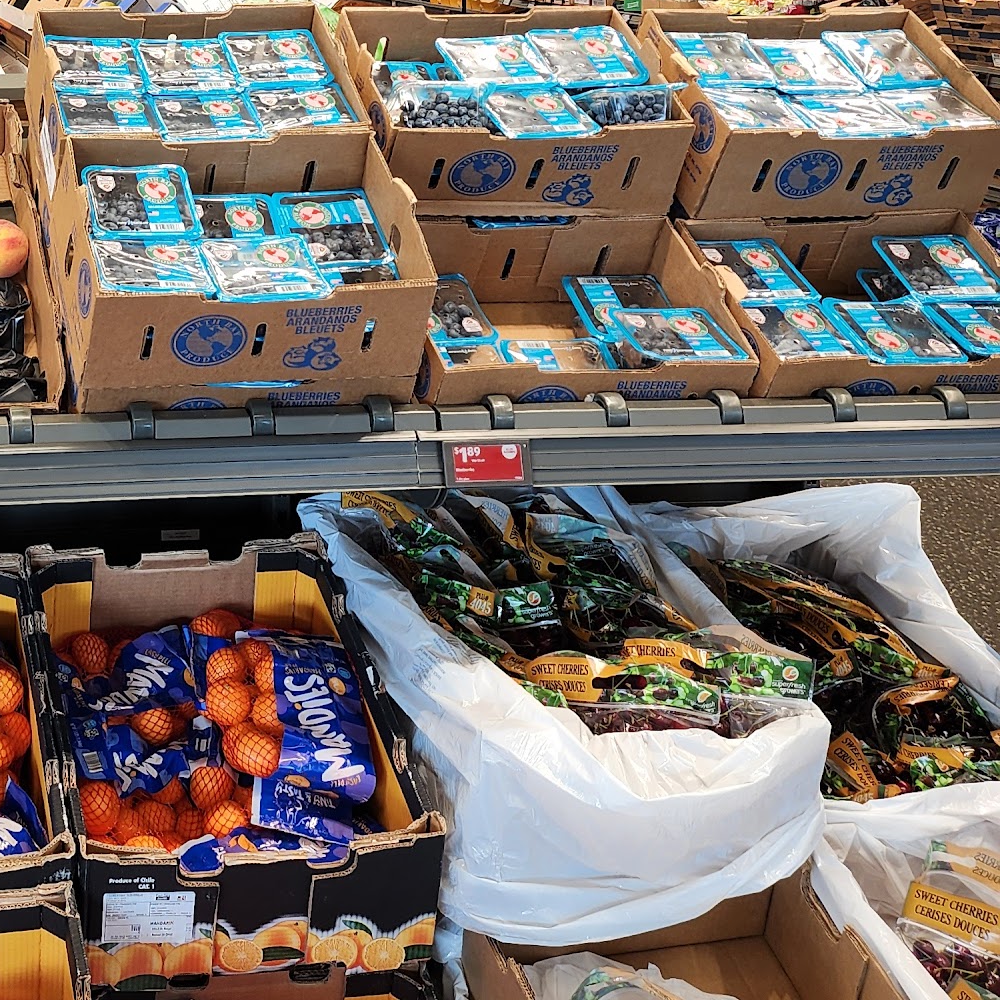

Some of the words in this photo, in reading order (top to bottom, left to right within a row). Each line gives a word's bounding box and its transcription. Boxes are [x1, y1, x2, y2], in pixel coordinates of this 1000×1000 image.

[552, 144, 620, 155] BLUEBERRIES
[879, 144, 945, 154] BLUEBERRIES
[457, 152, 495, 170] NORTH
[496, 154, 511, 171] BAY
[550, 153, 614, 163] ARANDANOS
[785, 152, 823, 171] NORTH
[826, 154, 839, 171] BAY
[877, 153, 939, 163] ARANDANOS
[557, 162, 602, 171] BLEUETS
[882, 162, 925, 171] BLEUETS
[454, 179, 501, 194] PRODUCE
[286, 305, 363, 318] BLUEBERRIES
[286, 315, 358, 327] ARANDANOS
[180, 318, 221, 339] NORTH
[224, 320, 242, 338] BAY
[295, 324, 345, 335] BLEUETS
[181, 348, 235, 364] PRODUCE
[617, 379, 688, 391] BLUEBERRIES
[936, 374, 1000, 384] BLUEBERRIE
[267, 391, 341, 402] BLUEBERRIES
[469, 598, 493, 614] 4045
[636, 645, 676, 658] CHERRIES
[531, 663, 556, 676] SWEET
[557, 663, 589, 676] CHERRIES
[564, 679, 587, 693] DOUCES
[771, 681, 807, 691] superfresh
[841, 737, 863, 763] SWEET
[833, 747, 860, 772] CERISES
[914, 888, 949, 907] SWEET
[949, 900, 999, 926] CHERRIES
[914, 904, 952, 926] CERISES
[953, 917, 991, 941] DOUCES
